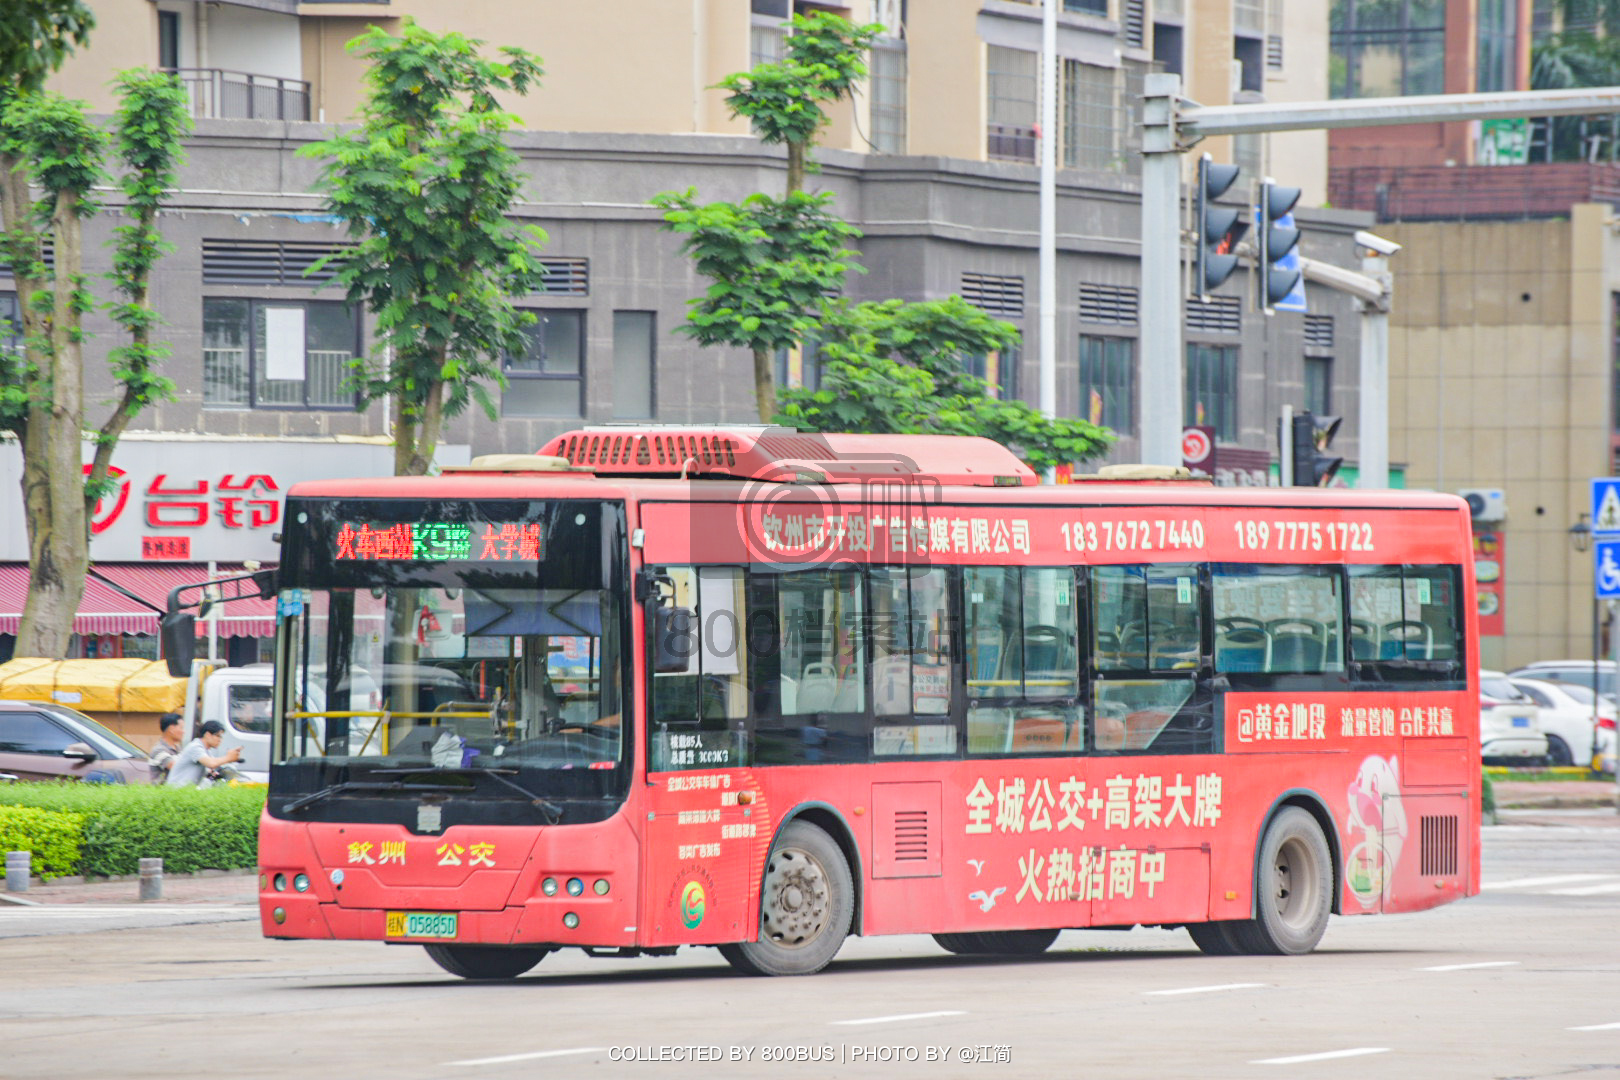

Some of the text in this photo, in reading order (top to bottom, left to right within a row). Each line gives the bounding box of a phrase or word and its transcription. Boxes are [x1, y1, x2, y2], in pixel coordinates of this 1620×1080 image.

[145, 473, 279, 528] 台铃
[763, 514, 1030, 555] 钦州市开投广告传媒有限公司
[1061, 520, 1204, 551] 183 7672 7440
[1234, 520, 1374, 551] 189 7775 1722
[1400, 706, 1454, 737] 合作共赢
[965, 773, 1222, 834] 全城公交+高架大牌
[436, 841, 497, 867] 公交
[1015, 844, 1166, 904] 火热招商中
